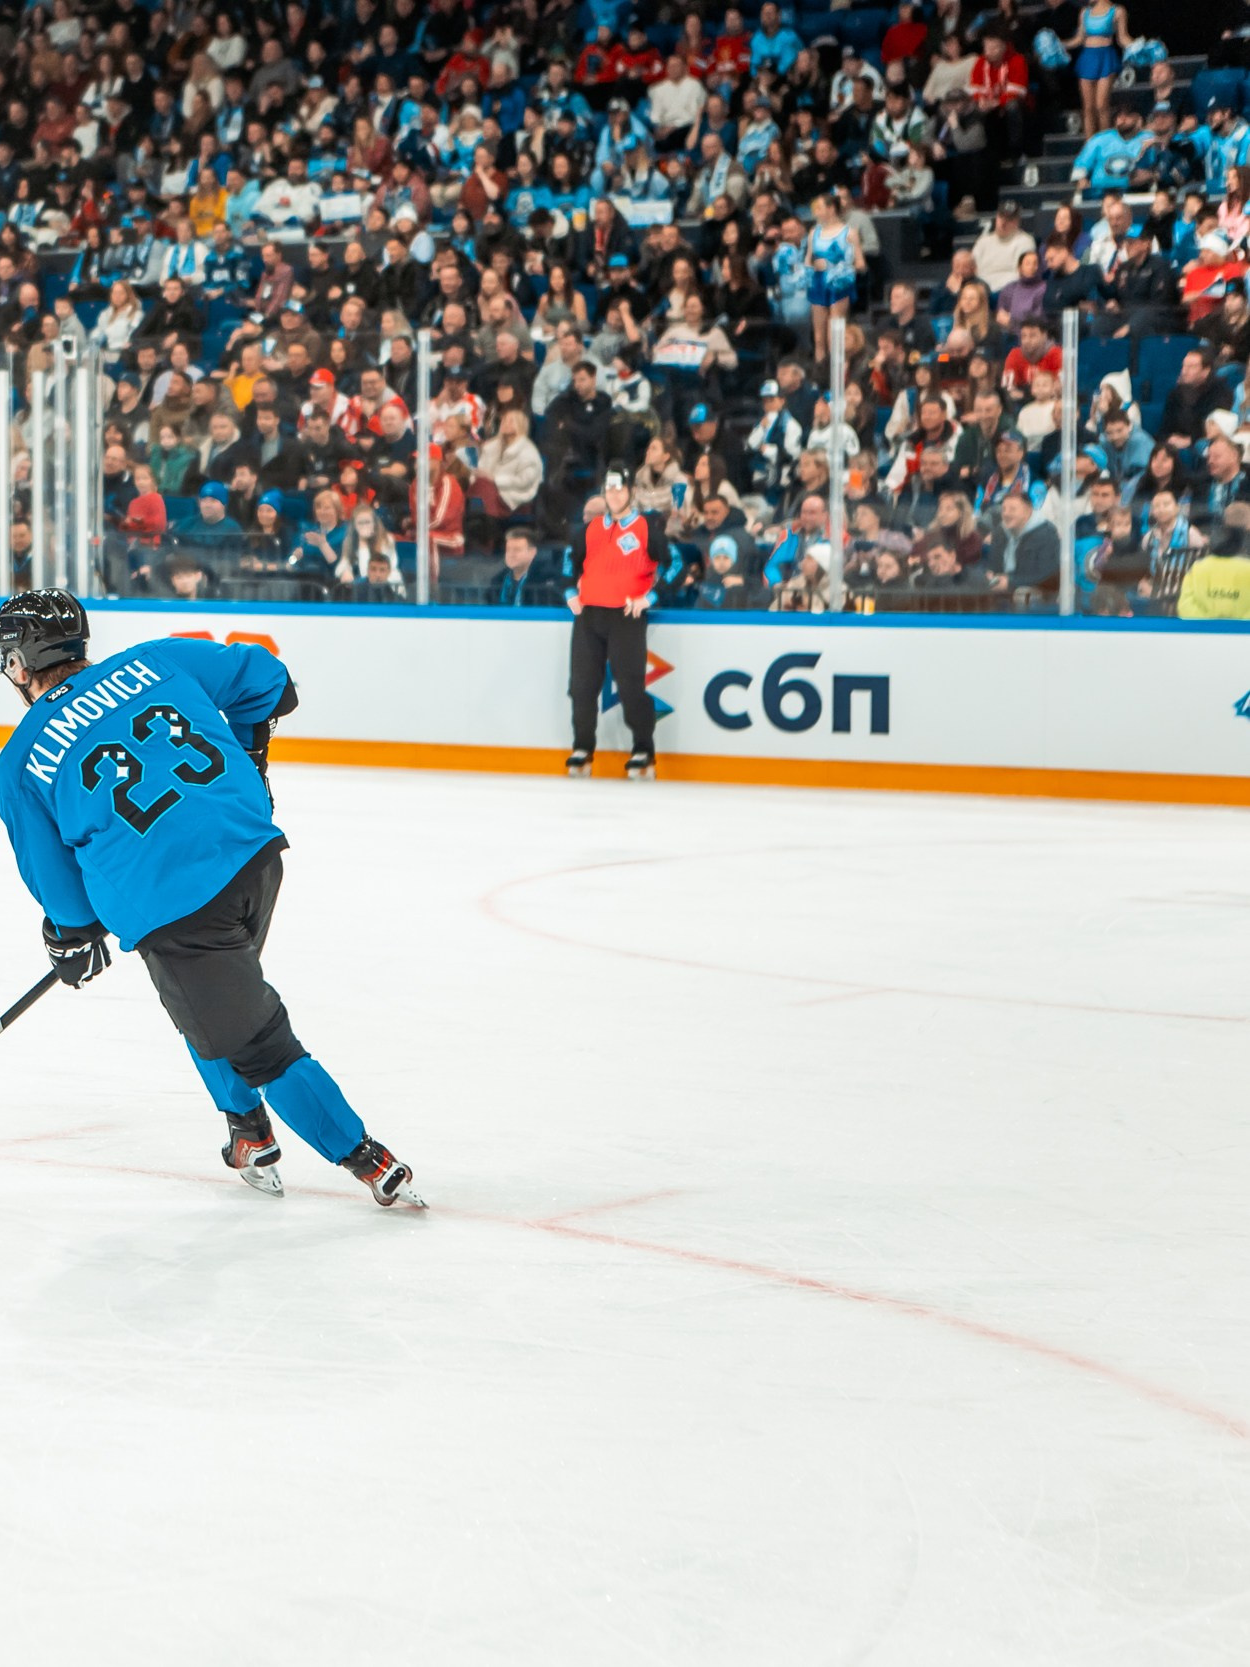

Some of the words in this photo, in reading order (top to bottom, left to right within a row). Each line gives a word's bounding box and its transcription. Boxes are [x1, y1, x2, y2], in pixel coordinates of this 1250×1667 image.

[2, 632, 18, 640] CCM
[26, 659, 161, 785] KLIMOVICH
[703, 652, 890, 735] сбп
[78, 703, 228, 838] 23
